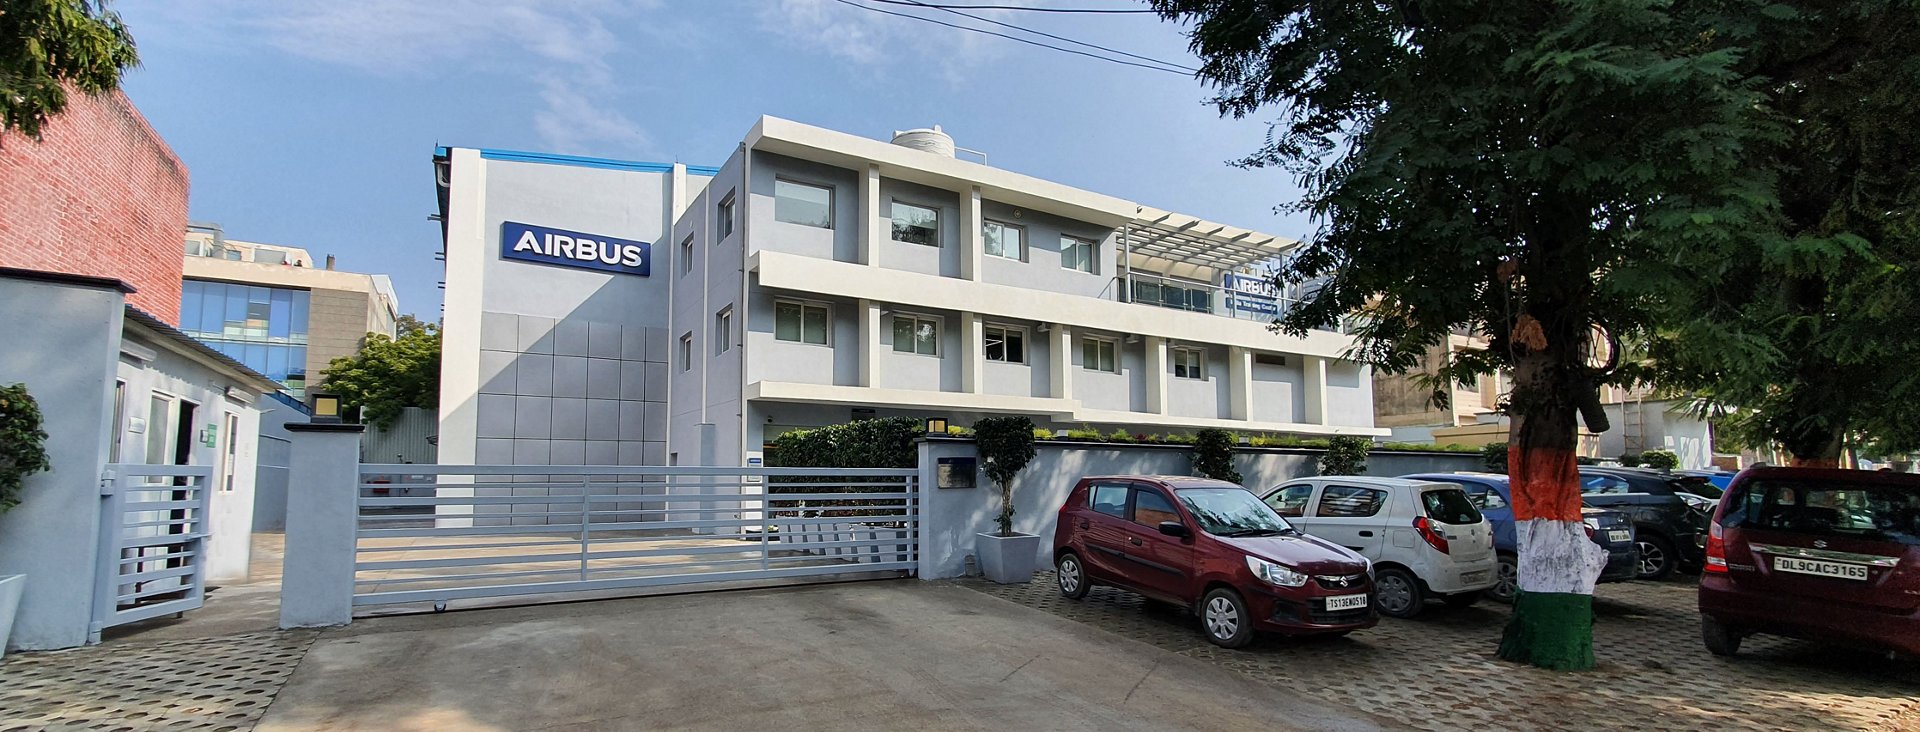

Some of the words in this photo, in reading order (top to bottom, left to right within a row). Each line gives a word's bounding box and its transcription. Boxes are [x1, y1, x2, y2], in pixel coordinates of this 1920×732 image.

[514, 230, 642, 267] AIRBUS
[1243, 300, 1261, 310] Traning
[1782, 559, 1866, 578] DL9CAC3165
